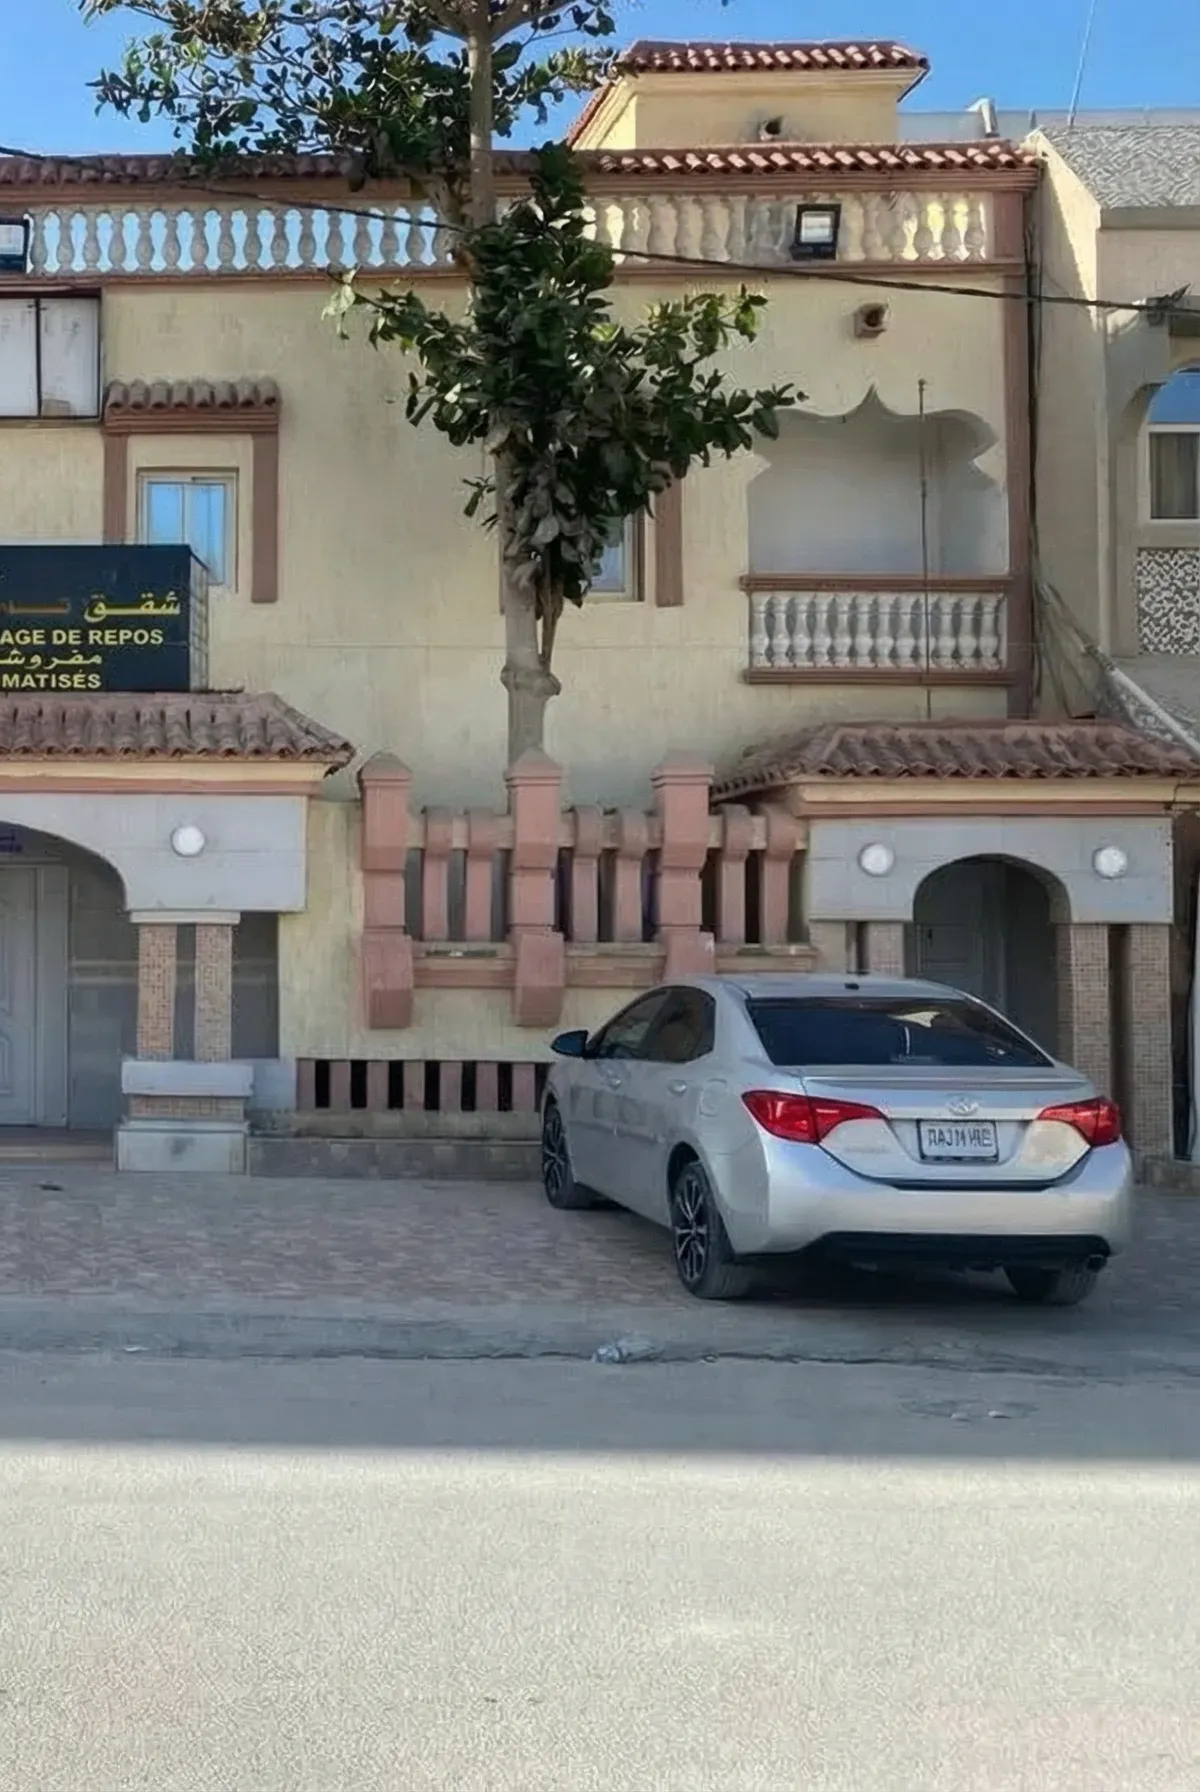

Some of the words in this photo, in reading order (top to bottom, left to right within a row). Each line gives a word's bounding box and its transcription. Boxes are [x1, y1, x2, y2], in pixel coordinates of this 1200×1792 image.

[83, 591, 181, 622] شقق
[52, 628, 82, 645] DE
[88, 628, 164, 645] REPOS
